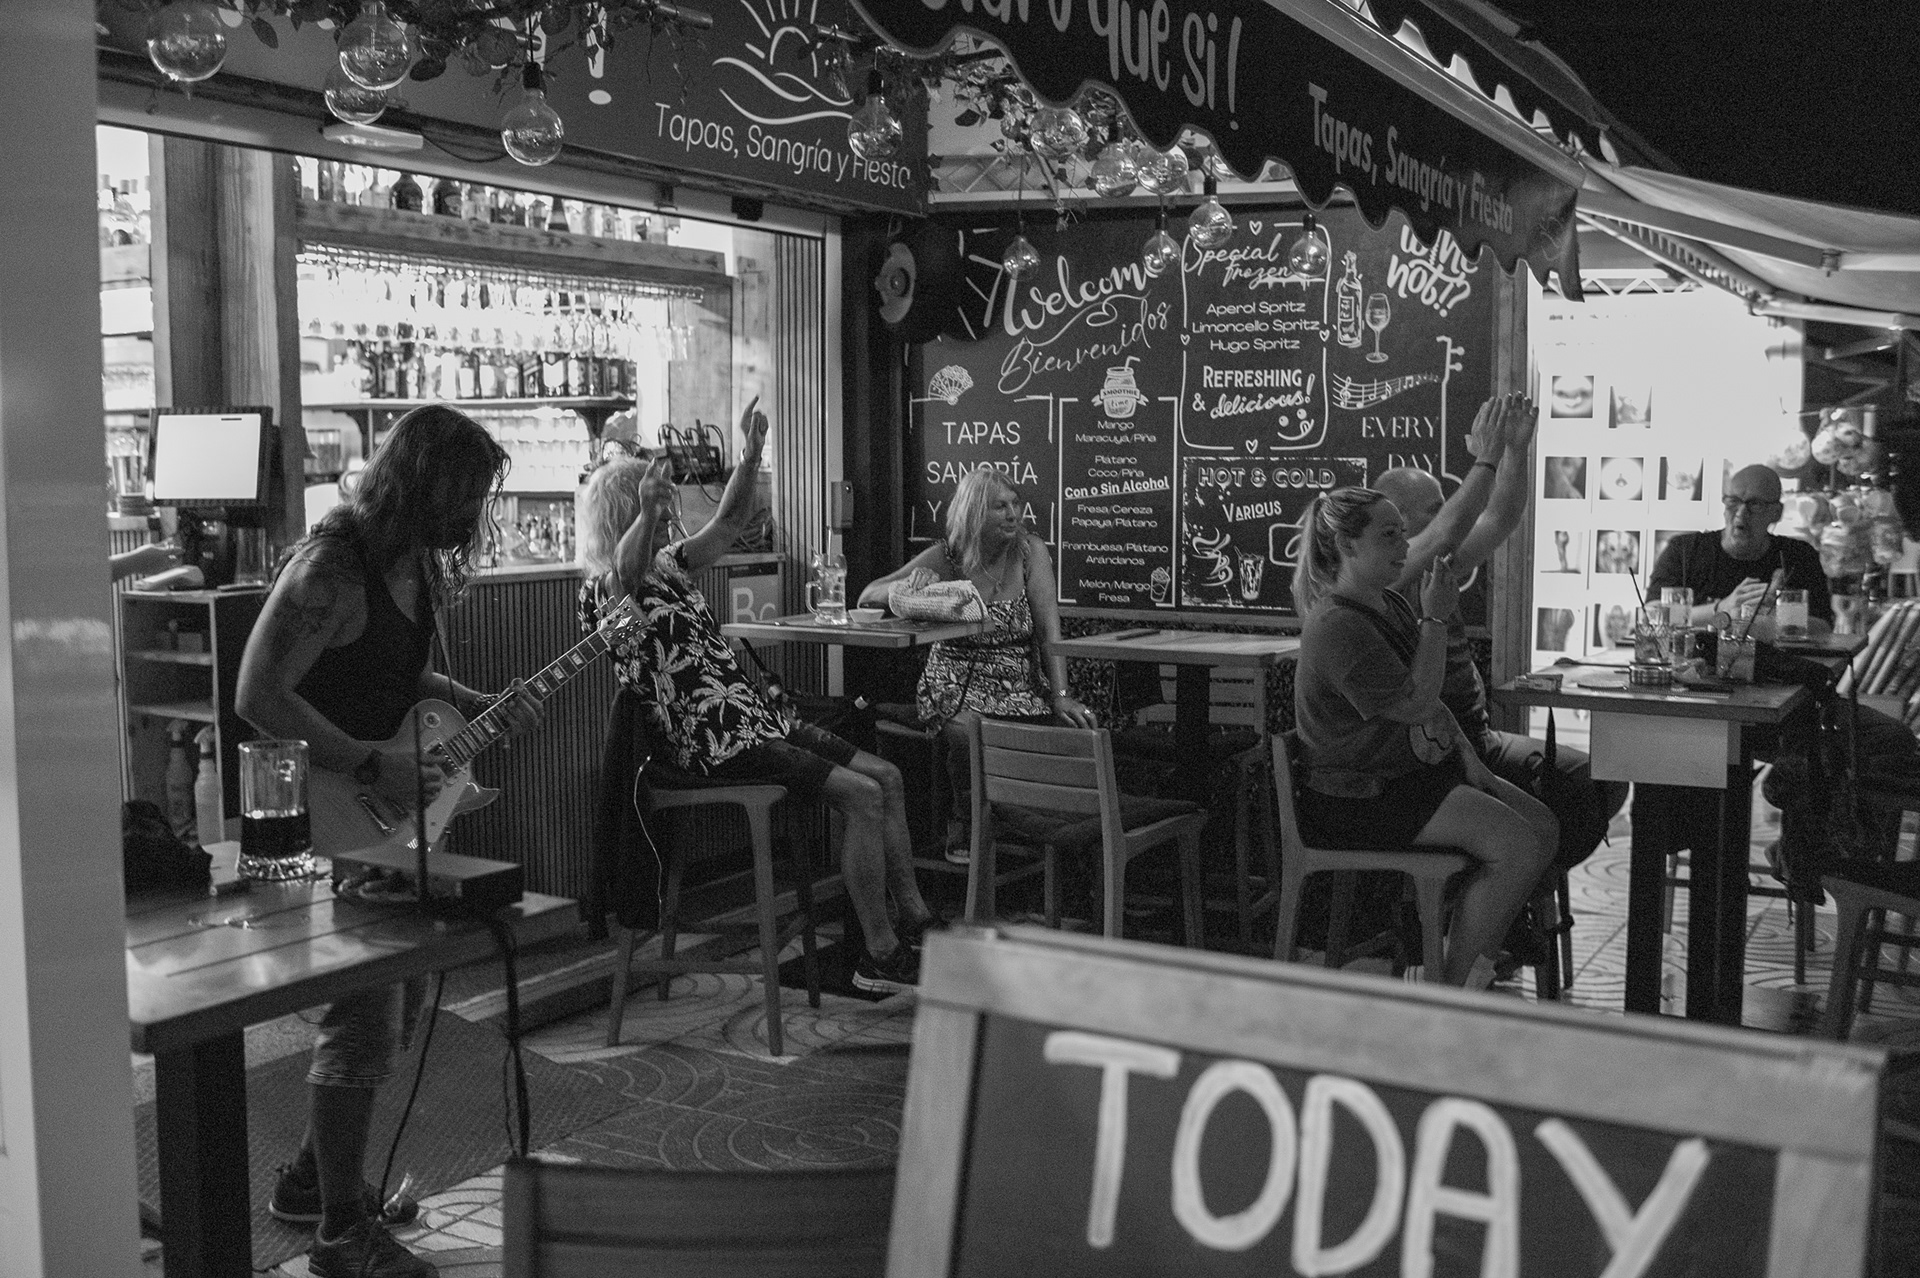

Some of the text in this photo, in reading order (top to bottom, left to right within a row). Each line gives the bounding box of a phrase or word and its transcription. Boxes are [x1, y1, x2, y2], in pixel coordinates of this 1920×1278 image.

[655, 102, 739, 158] Tapas,
[746, 124, 832, 175] Sangría
[835, 152, 849, 182] y
[1308, 81, 1378, 187] Tapas,
[1456, 181, 1467, 228] y
[1470, 171, 1513, 235] Fiesta
[1183, 232, 1282, 277] Special
[1206, 301, 1306, 317] Aperol Spritz
[1192, 319, 1320, 333] Limoncello Spritz
[998, 298, 1171, 394] Bienvenidos
[1210, 338, 1300, 353] Hugo Spritz
[1192, 392, 1206, 412] &
[942, 421, 1021, 445] TAPAS
[1097, 420, 1135, 431] Mango
[1362, 416, 1440, 438] EVERY
[1064, 475, 1170, 499] Con o Sin Alcohol
[1198, 467, 1246, 488] HOT
[1272, 467, 1336, 489] COLD
[927, 500, 942, 523] Y
[1077, 503, 1153, 515] Fresa/Cereza
[1098, 592, 1130, 603] Fresa
[1044, 1030, 1711, 1278] TODAY
